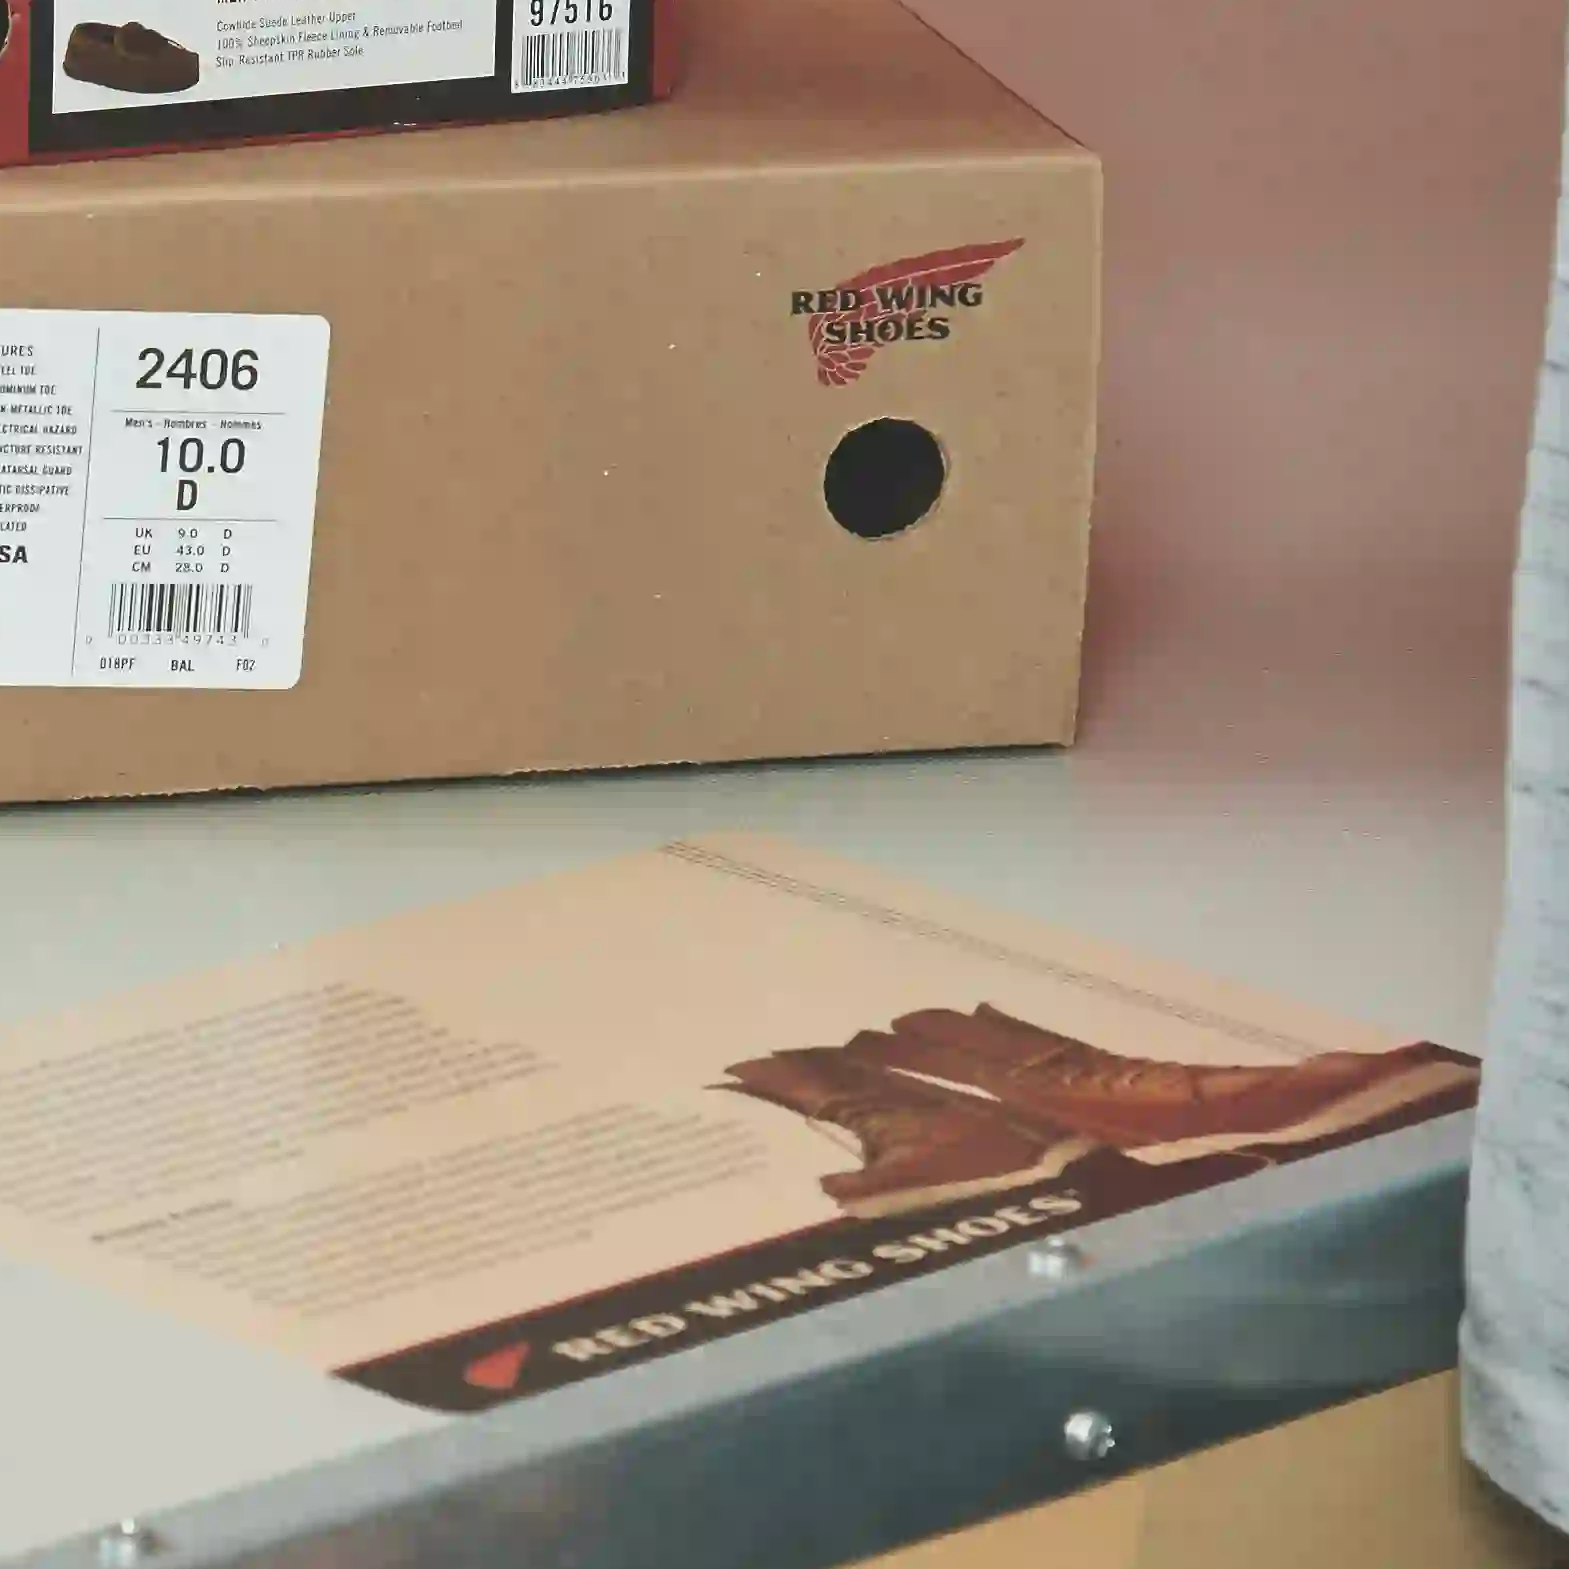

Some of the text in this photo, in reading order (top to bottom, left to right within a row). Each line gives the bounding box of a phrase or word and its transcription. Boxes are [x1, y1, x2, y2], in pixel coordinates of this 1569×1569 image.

[216, 11, 356, 32] Cowhide Suede Leather Upper
[790, 282, 983, 317] RED WING
[823, 317, 951, 345] SHOES
[135, 347, 260, 391] 2406
[156, 436, 246, 474] 10.0
[175, 479, 198, 511] D
[135, 528, 153, 539] UK
[223, 529, 232, 539] D
[134, 545, 231, 557] EU 43.0 D
[131, 562, 229, 573] CM 28.0 D
[171, 659, 195, 672] BAL
[553, 1193, 1082, 1364] RED WING SHOES
